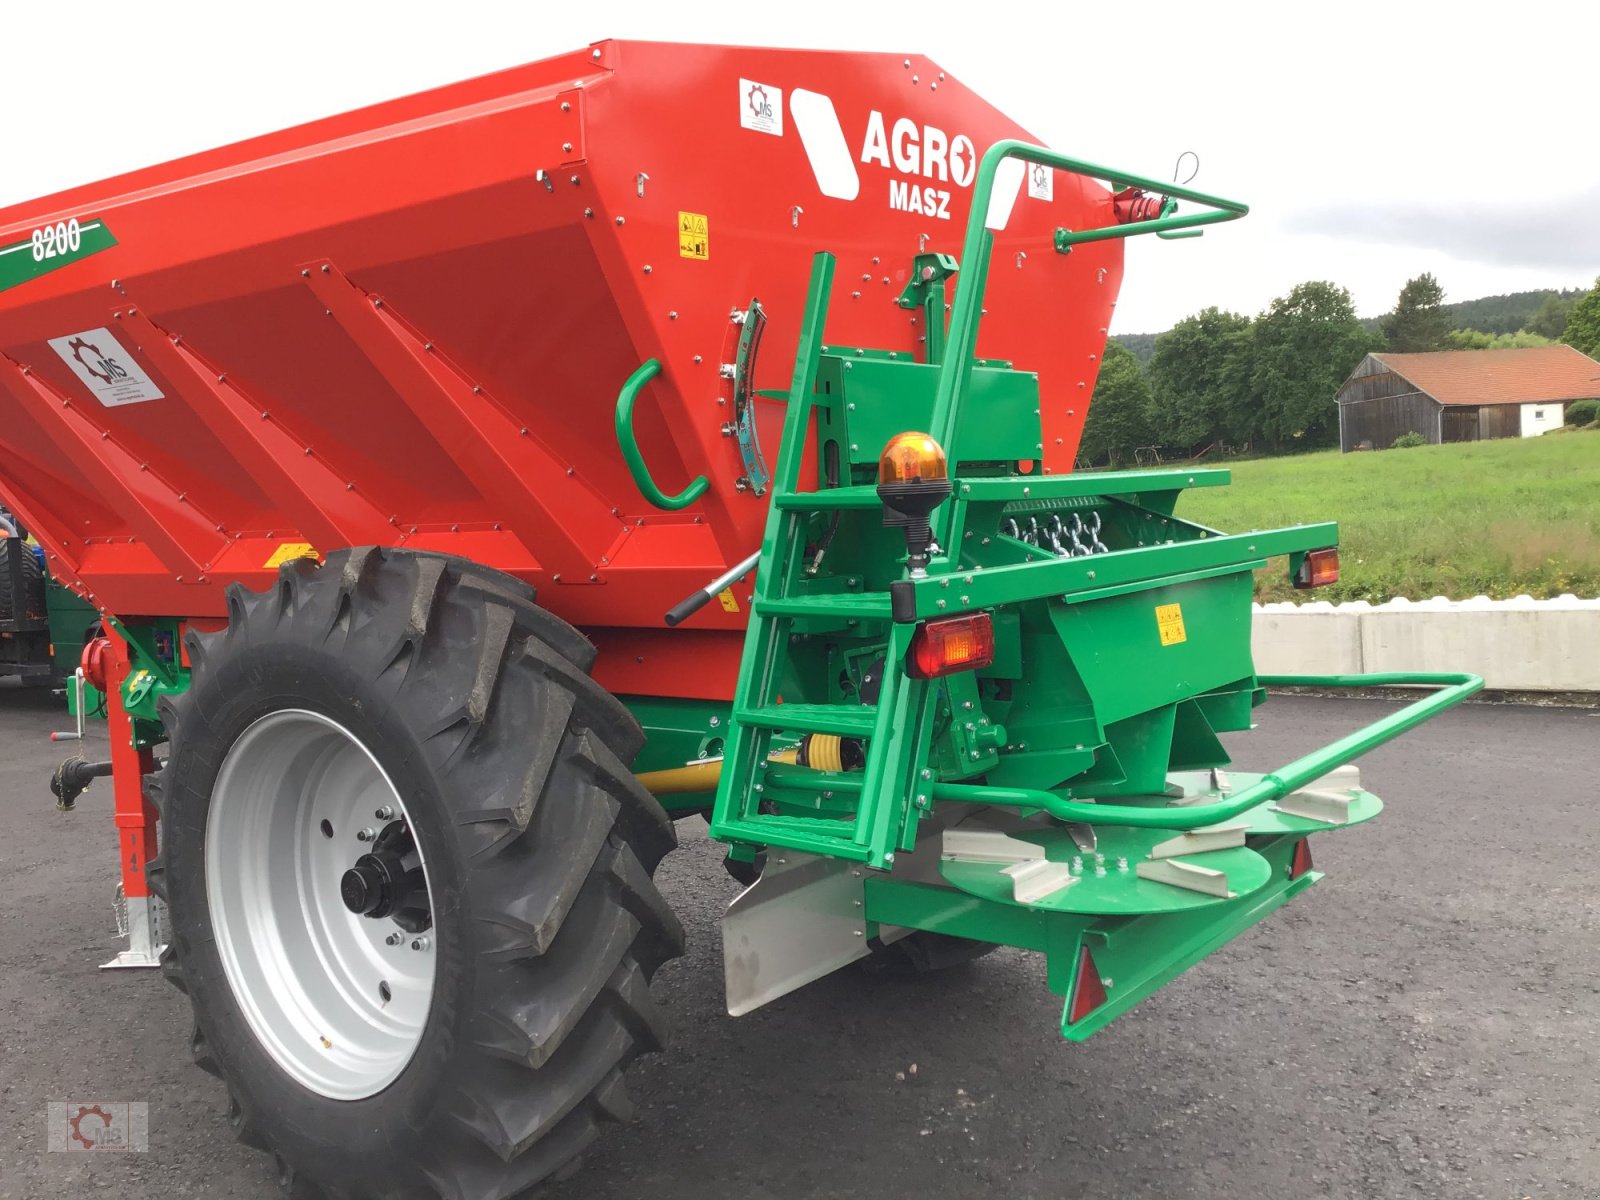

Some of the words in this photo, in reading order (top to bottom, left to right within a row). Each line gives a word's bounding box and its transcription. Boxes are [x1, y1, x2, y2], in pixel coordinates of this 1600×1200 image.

[760, 101, 772, 117] MS
[860, 109, 976, 187] AGRO
[889, 179, 951, 220] MASZ
[32, 218, 81, 262] 8200
[97, 358, 128, 379] MS
